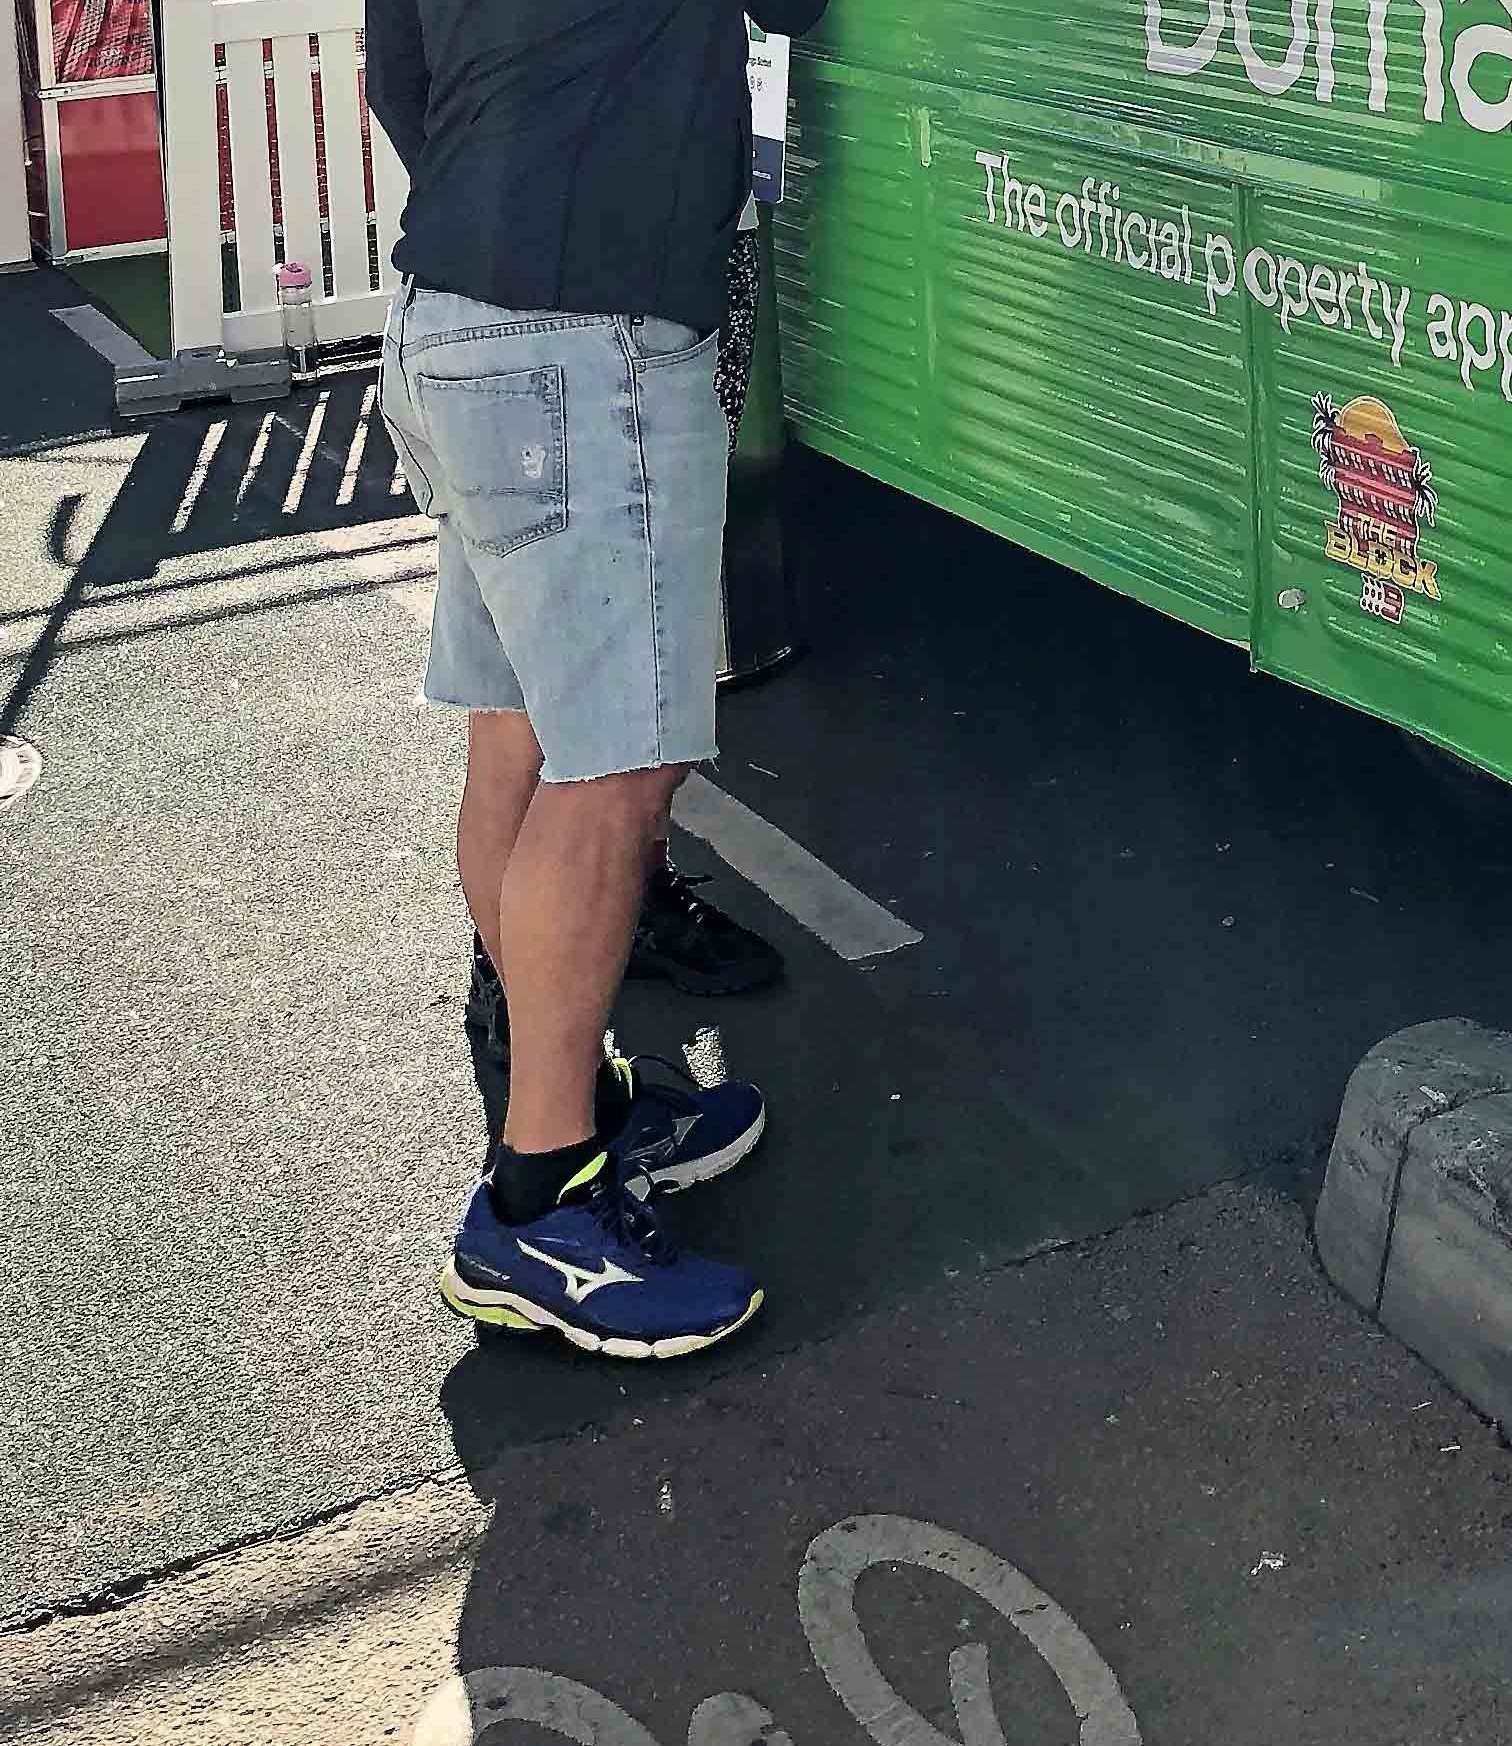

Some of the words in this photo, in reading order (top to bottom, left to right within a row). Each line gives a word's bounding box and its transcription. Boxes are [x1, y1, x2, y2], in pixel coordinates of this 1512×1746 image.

[974, 150, 1050, 239] The
[1057, 177, 1193, 285] official
[1323, 519, 1442, 602] BLOCK
[1357, 512, 1399, 544] THE
